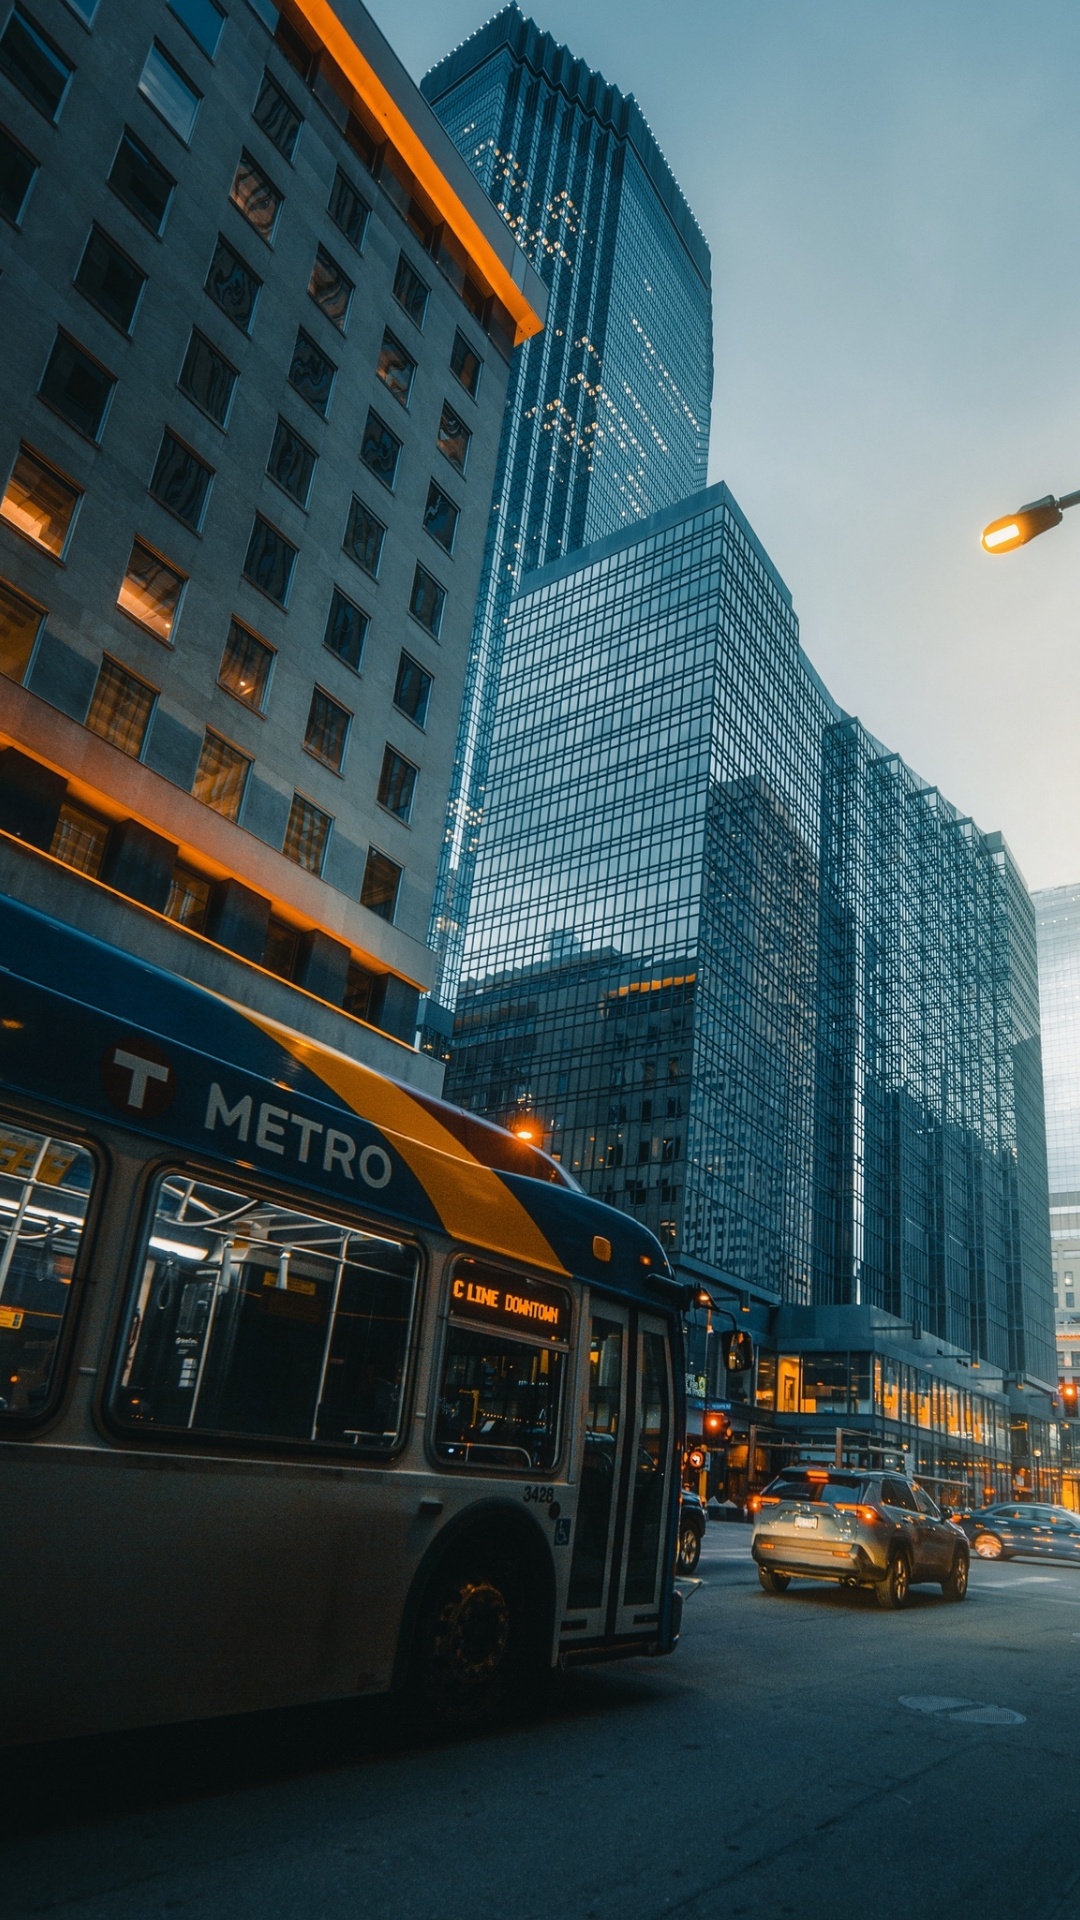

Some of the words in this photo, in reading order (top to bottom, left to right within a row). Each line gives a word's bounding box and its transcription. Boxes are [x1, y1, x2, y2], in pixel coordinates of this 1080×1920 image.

[113, 1048, 169, 1110] T
[204, 1082, 392, 1189] METRO
[453, 1280, 464, 1298] C
[466, 1283, 499, 1308] LINE
[505, 1294, 559, 1324] DOWNTOWN
[523, 1485, 554, 1503] 3428
